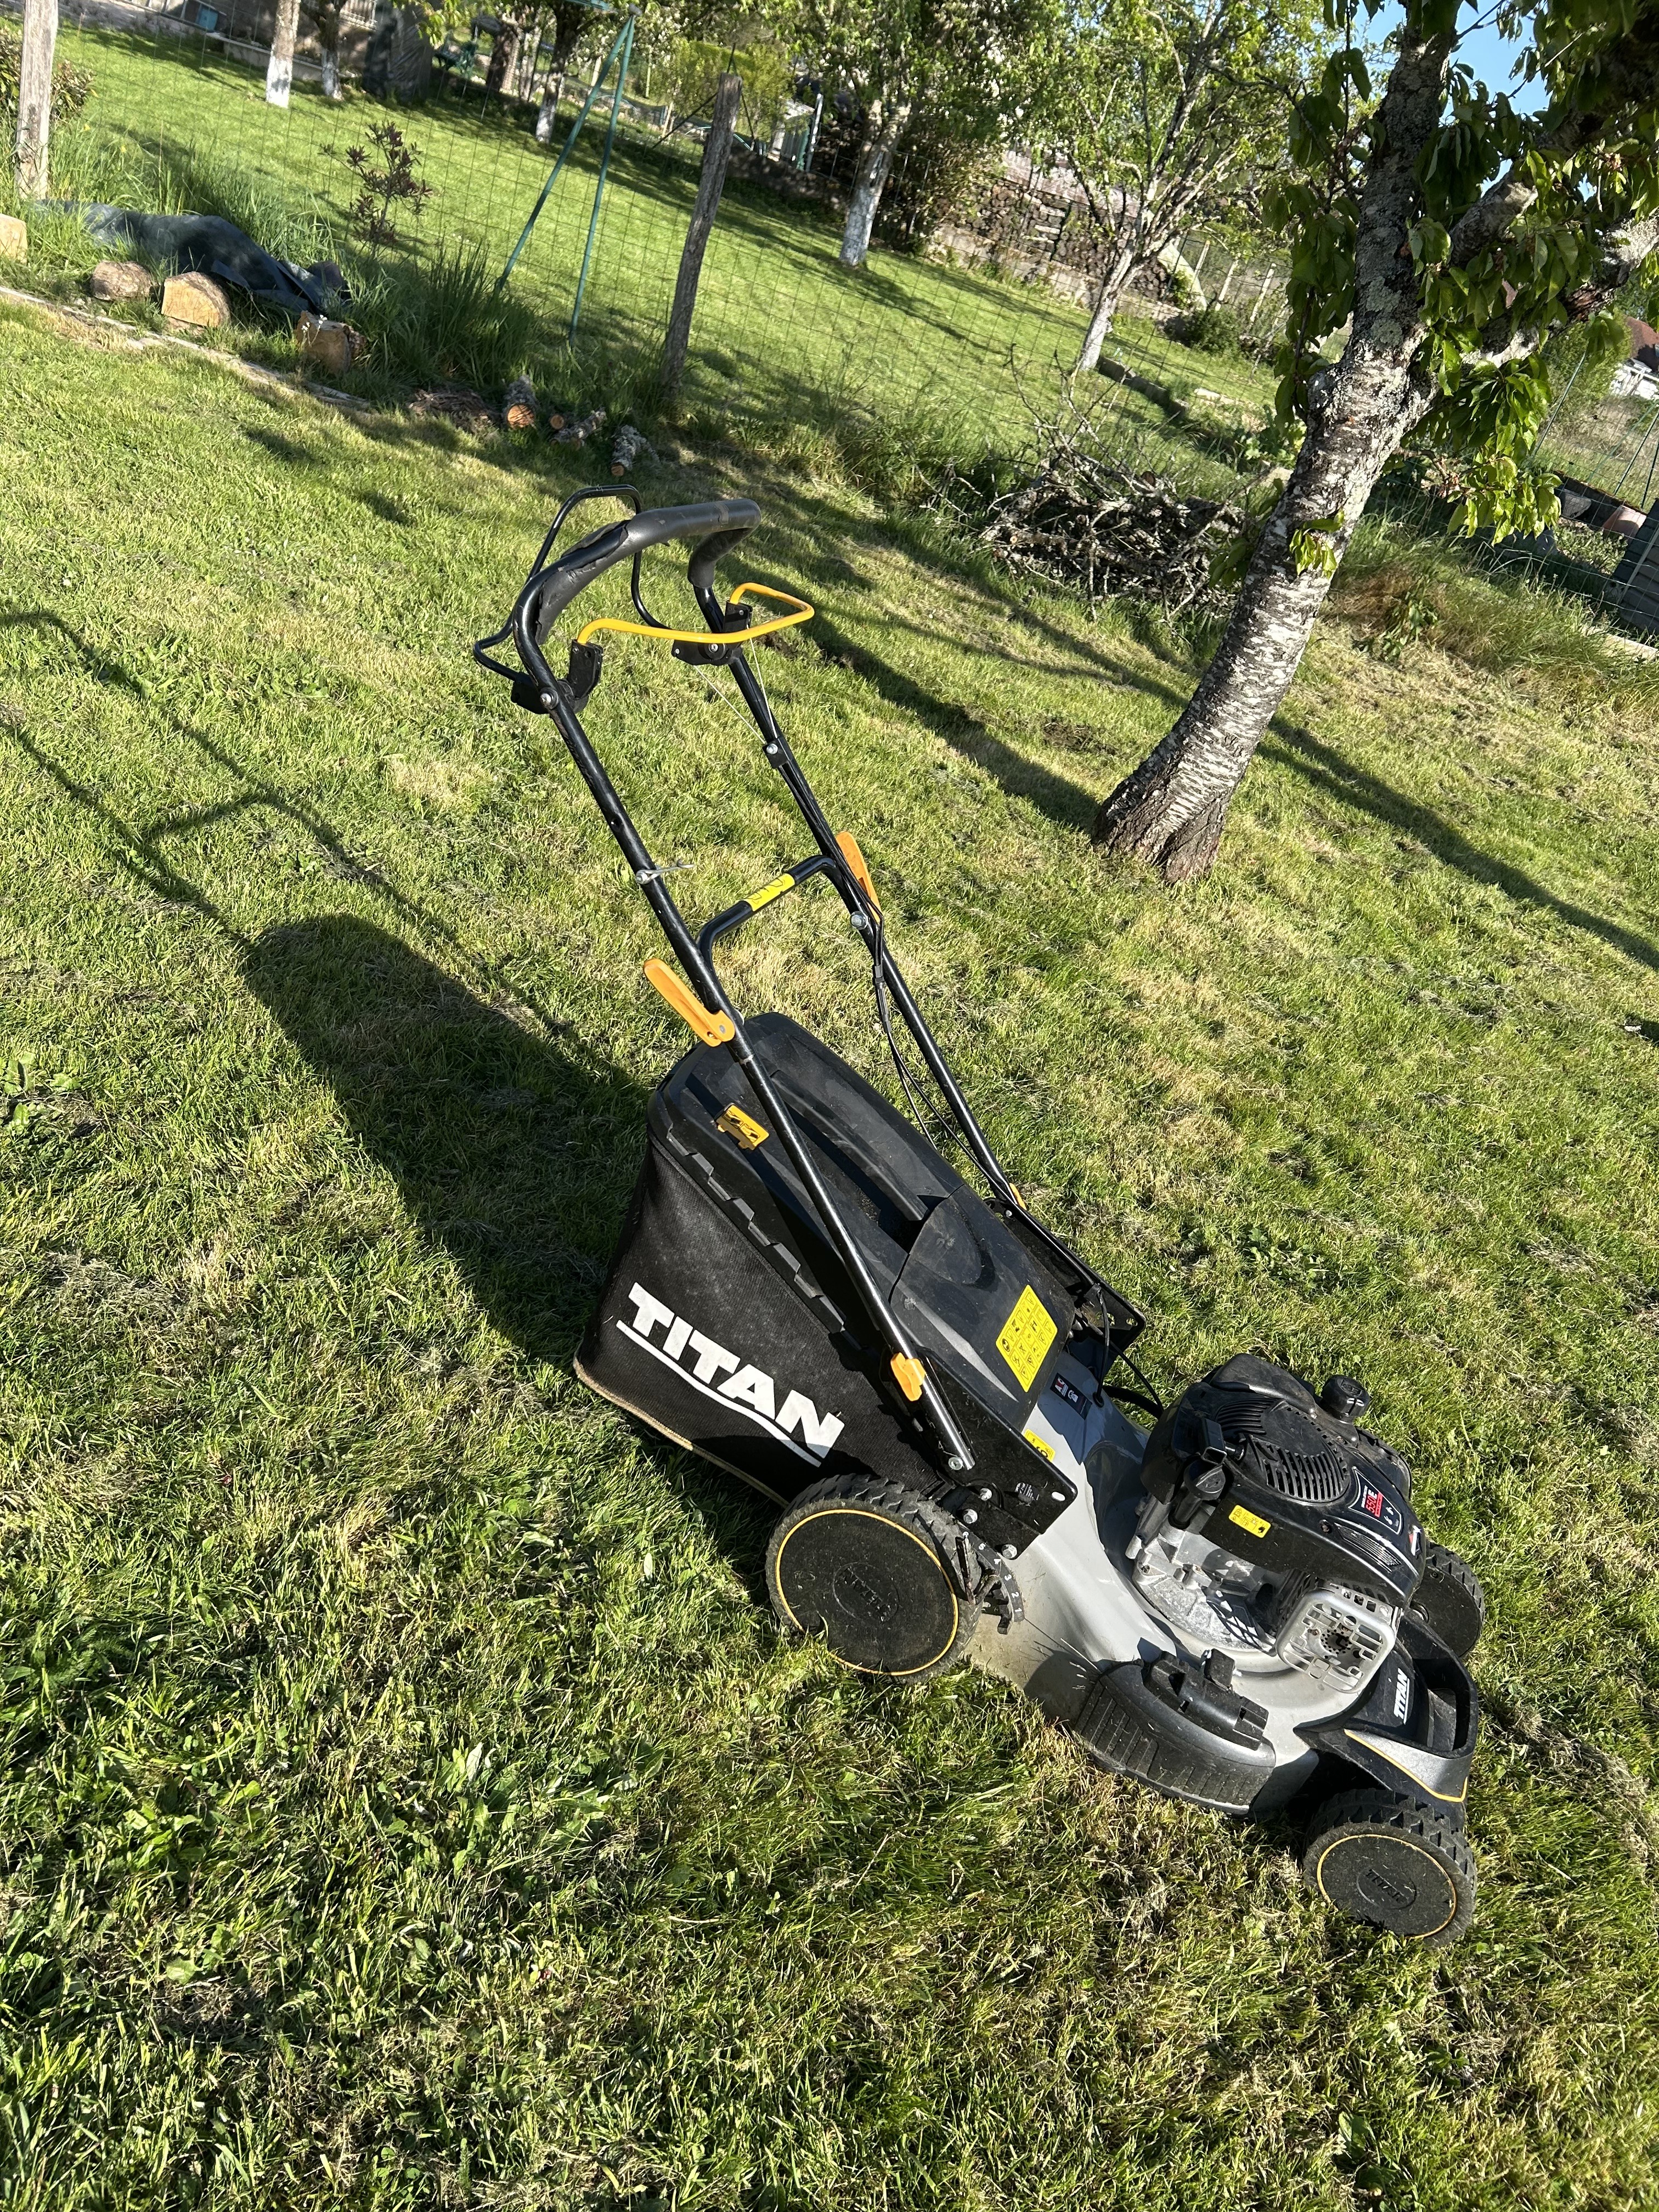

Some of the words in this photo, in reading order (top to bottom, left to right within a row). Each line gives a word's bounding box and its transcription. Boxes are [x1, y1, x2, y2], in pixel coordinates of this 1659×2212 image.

[628, 1282, 845, 1459] TITAN
[1365, 1488, 1378, 1513] 550E
[1393, 1667, 1408, 1719] TITAN
